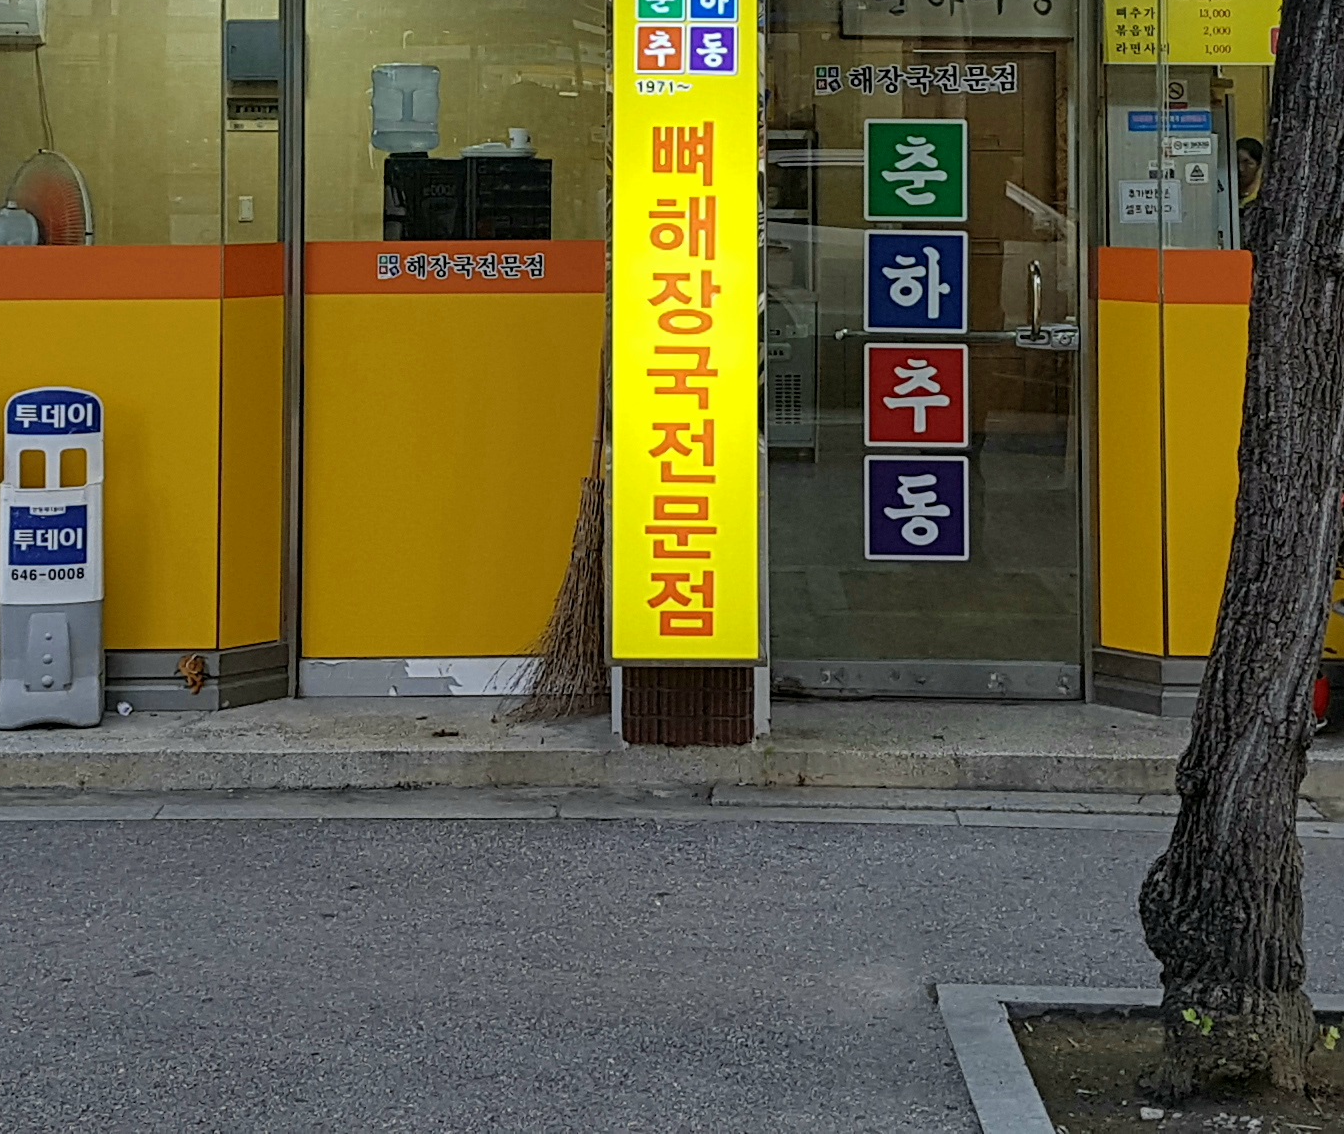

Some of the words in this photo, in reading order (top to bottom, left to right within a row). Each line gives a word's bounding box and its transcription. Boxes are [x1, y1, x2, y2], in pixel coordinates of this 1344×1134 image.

[1202, 25, 1232, 37] 2,000
[1204, 43, 1232, 56] 1,000
[636, 79, 692, 94] 1971~
[849, 62, 1019, 95] 해장국전문점
[406, 253, 546, 280] 해장국전문점
[14, 403, 94, 429] 투데이
[12, 527, 84, 551] 투데이
[11, 567, 85, 582] 646-0008
